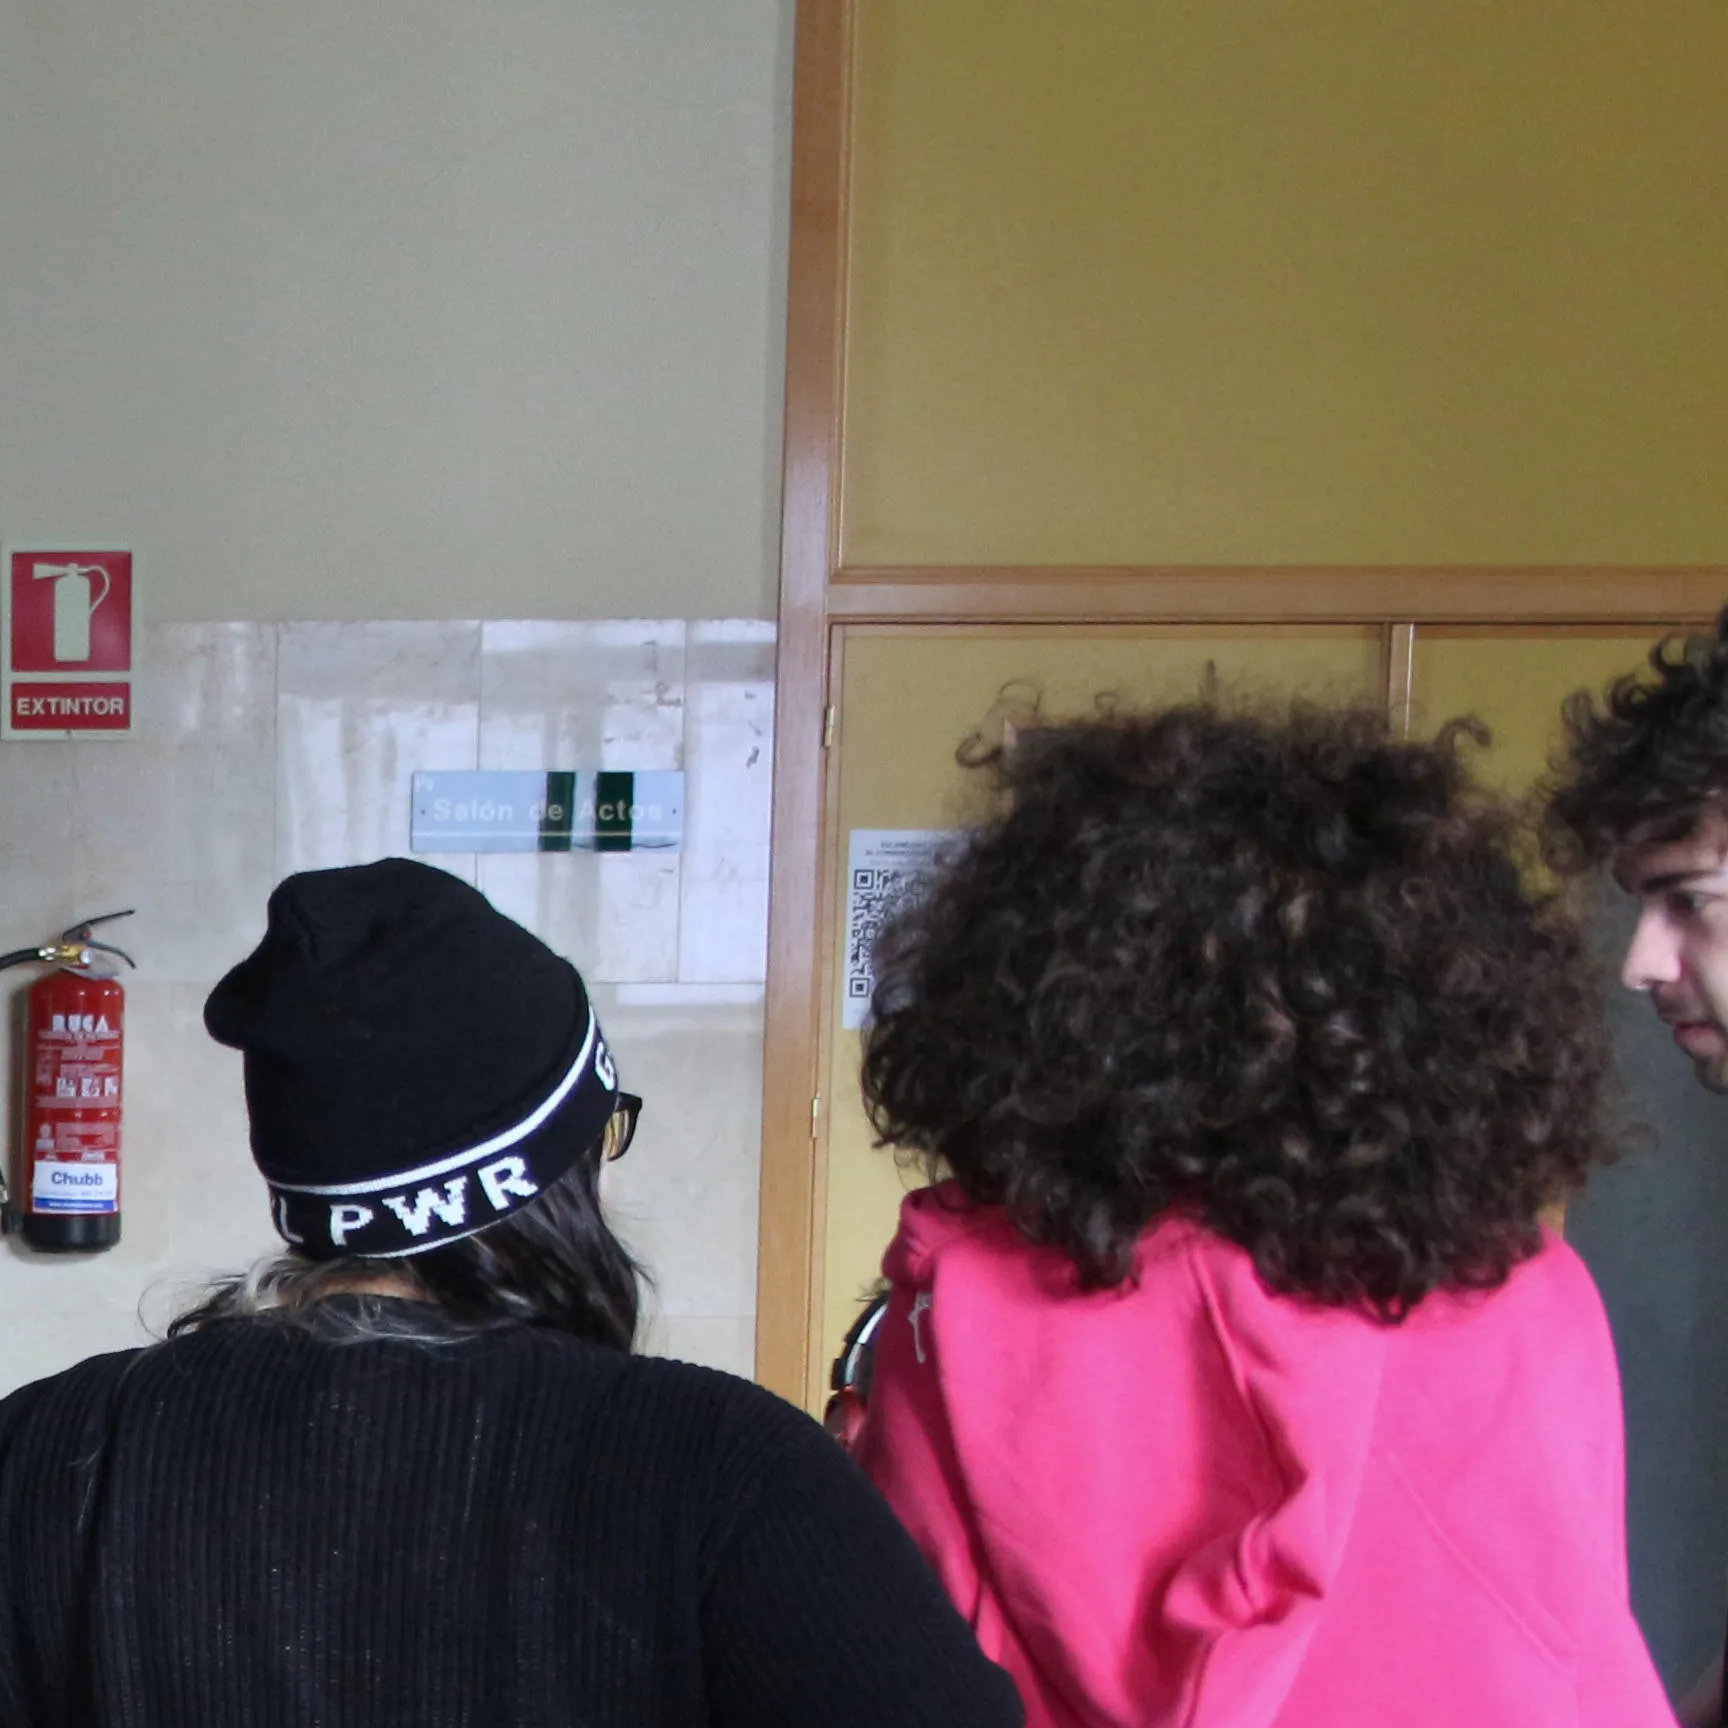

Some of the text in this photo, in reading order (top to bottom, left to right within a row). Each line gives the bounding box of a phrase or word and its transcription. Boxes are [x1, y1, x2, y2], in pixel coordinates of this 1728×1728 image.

[16, 696, 124, 716] EXTINTOR
[433, 797, 664, 822] Salón de Actos
[52, 1014, 109, 1033] RUCA
[51, 1171, 104, 1186] Chubb
[328, 1156, 540, 1246] PWR
